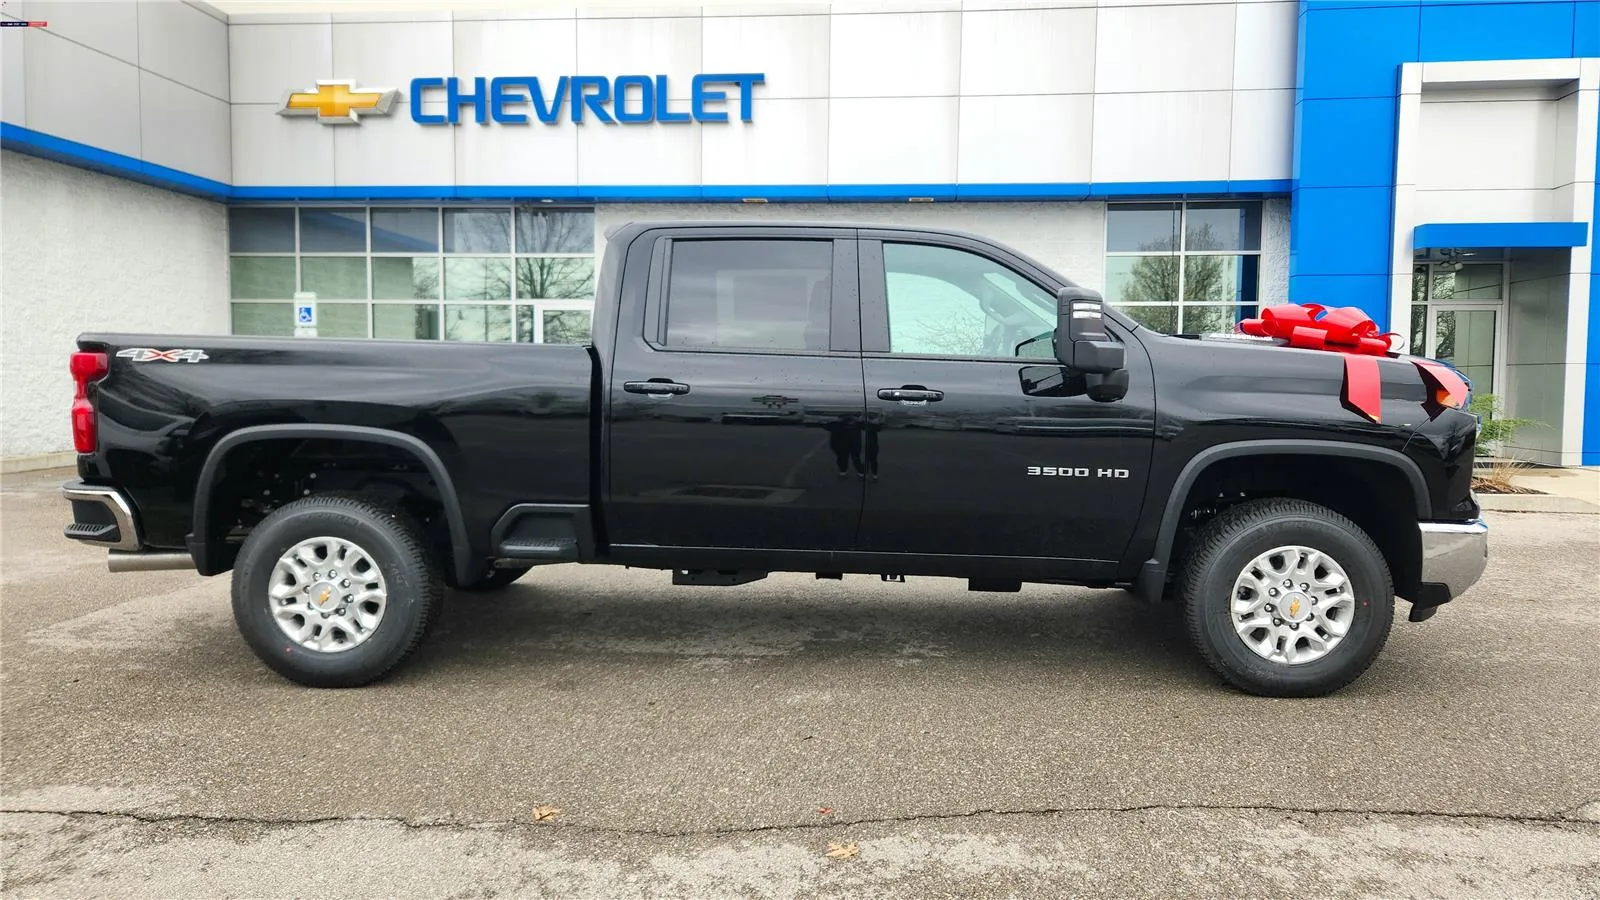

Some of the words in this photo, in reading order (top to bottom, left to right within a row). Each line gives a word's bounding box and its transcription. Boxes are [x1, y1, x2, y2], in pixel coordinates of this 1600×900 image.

[410, 73, 765, 125] CHEVROLET
[1027, 466, 1090, 477] 3500
[1097, 468, 1130, 479] HD
